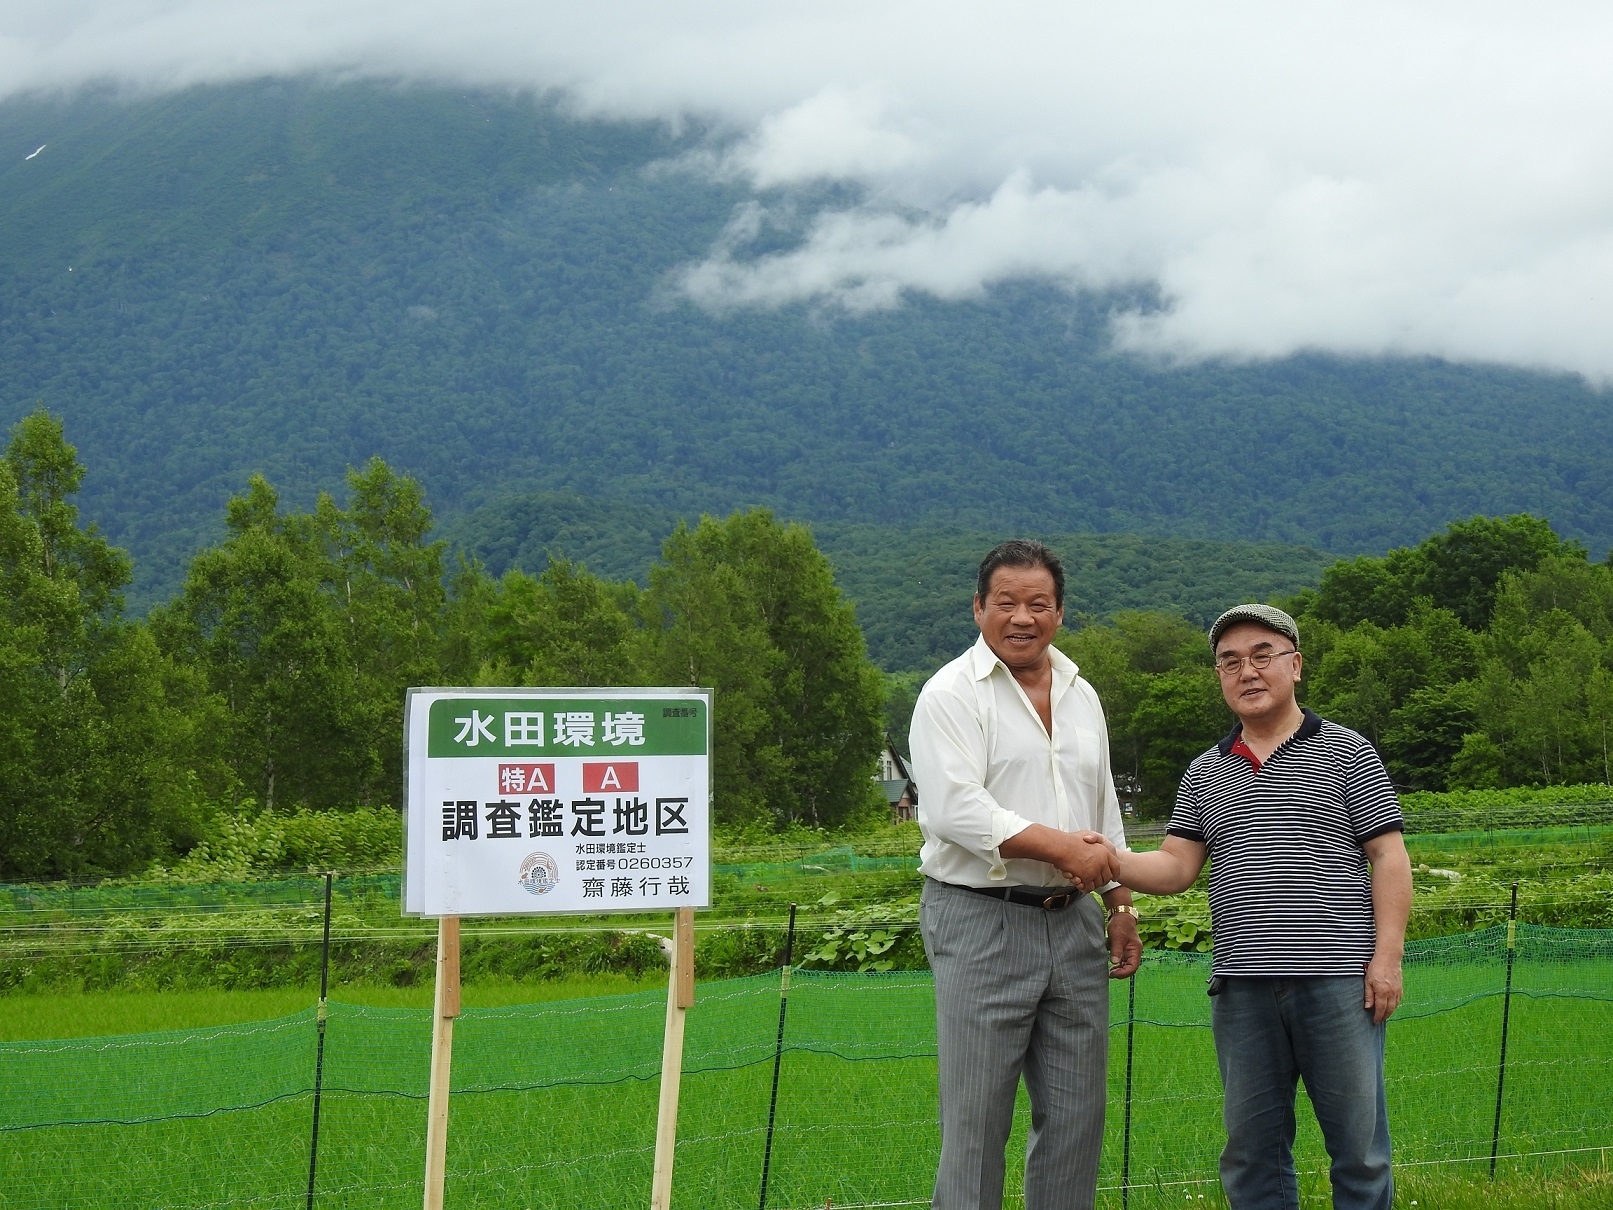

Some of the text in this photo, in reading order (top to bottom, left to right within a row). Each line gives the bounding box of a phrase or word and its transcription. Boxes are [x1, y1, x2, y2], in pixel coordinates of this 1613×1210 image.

[662, 707, 697, 718] 調査番号
[454, 710, 646, 747] 水田環境
[501, 766, 621, 792] 特A A
[442, 797, 690, 842] 調査鑑定地区
[575, 843, 646, 854] 水田環境鑑定士
